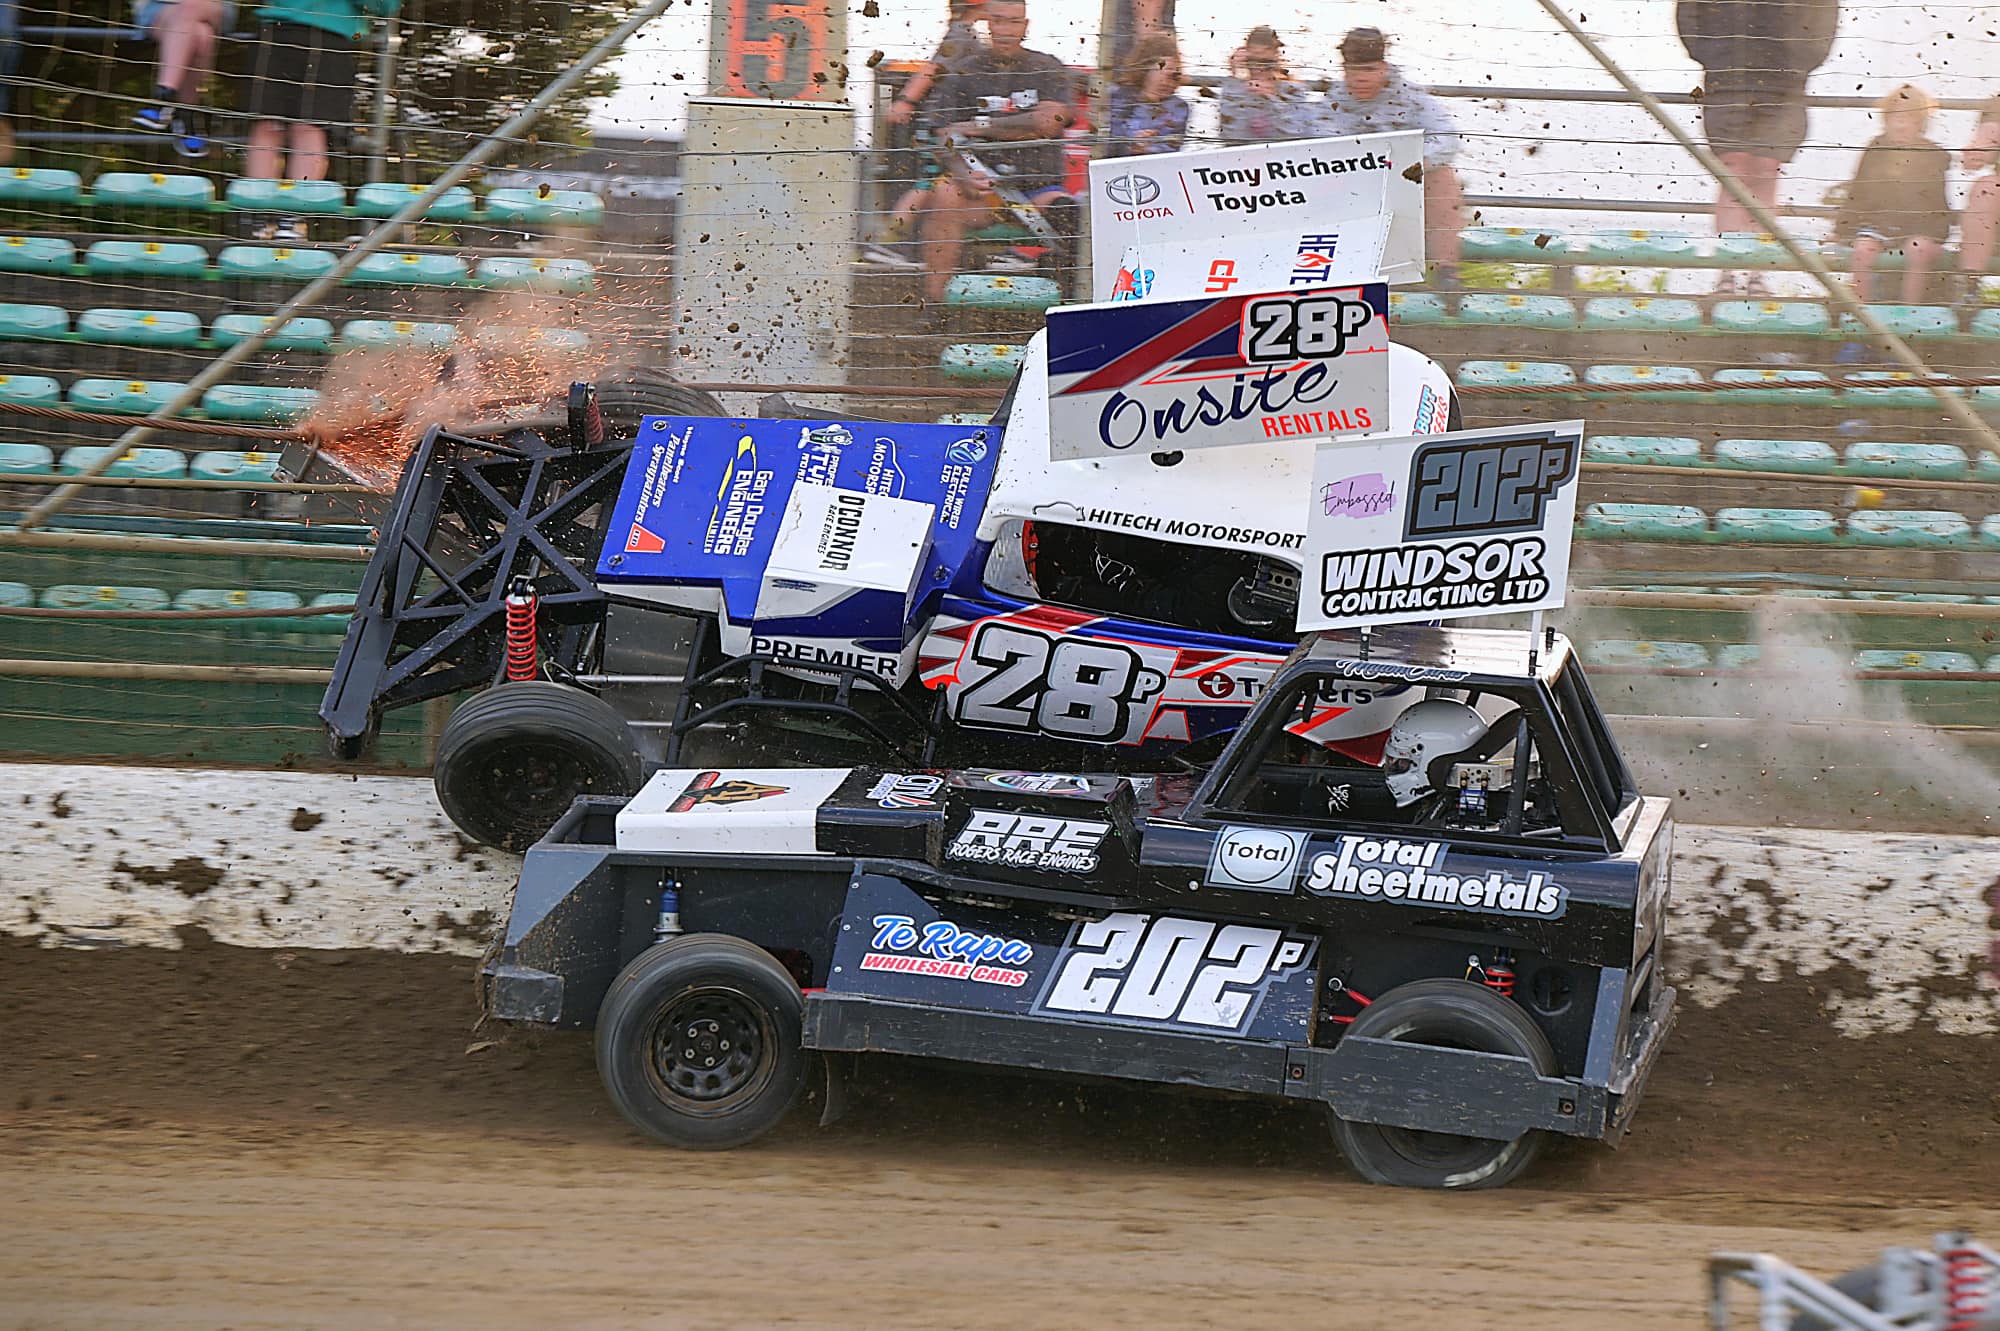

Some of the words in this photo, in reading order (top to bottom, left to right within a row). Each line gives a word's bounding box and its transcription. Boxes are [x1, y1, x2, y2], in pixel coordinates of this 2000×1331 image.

[1193, 166, 1260, 188] Tony
[1266, 151, 1388, 181] Richards
[1113, 207, 1174, 222] TOYOTA
[1207, 189, 1307, 214] Toyota
[1099, 362, 1339, 449] Onsite
[1261, 408, 1372, 438] RENTALS
[1411, 384, 1437, 435] BOUT
[634, 444, 665, 524] Spraypainters
[652, 433, 680, 508] Panelbeaters
[747, 470, 774, 502] Gary
[957, 465, 974, 497] FULLY
[713, 470, 753, 554] ENGINEERS
[826, 504, 838, 524] RACE
[948, 497, 965, 529] WIRED
[1320, 479, 1396, 516] Embossed
[733, 505, 764, 556] Douglas
[817, 524, 831, 555] ENGINES
[819, 495, 866, 571] O'CONNOR
[1089, 508, 1160, 533] HITECH
[1165, 519, 1306, 549] MOTORSPORT
[1324, 539, 1544, 594] WINDSOR
[1326, 582, 1496, 614] CONTRACTING
[1502, 578, 1546, 601] LTD
[751, 637, 897, 676] PREMIER
[950, 842, 1001, 860] ROGERS
[1002, 847, 1037, 865] RACE
[1038, 851, 1097, 870] ENGINES
[1226, 841, 1288, 863] Total
[1341, 835, 1441, 868] Total
[1308, 853, 1561, 913] Sheetmetals
[873, 915, 917, 949] Te
[920, 923, 1032, 963] Rapa
[864, 955, 971, 977] WHOLESALE
[972, 967, 1026, 985] CARS
